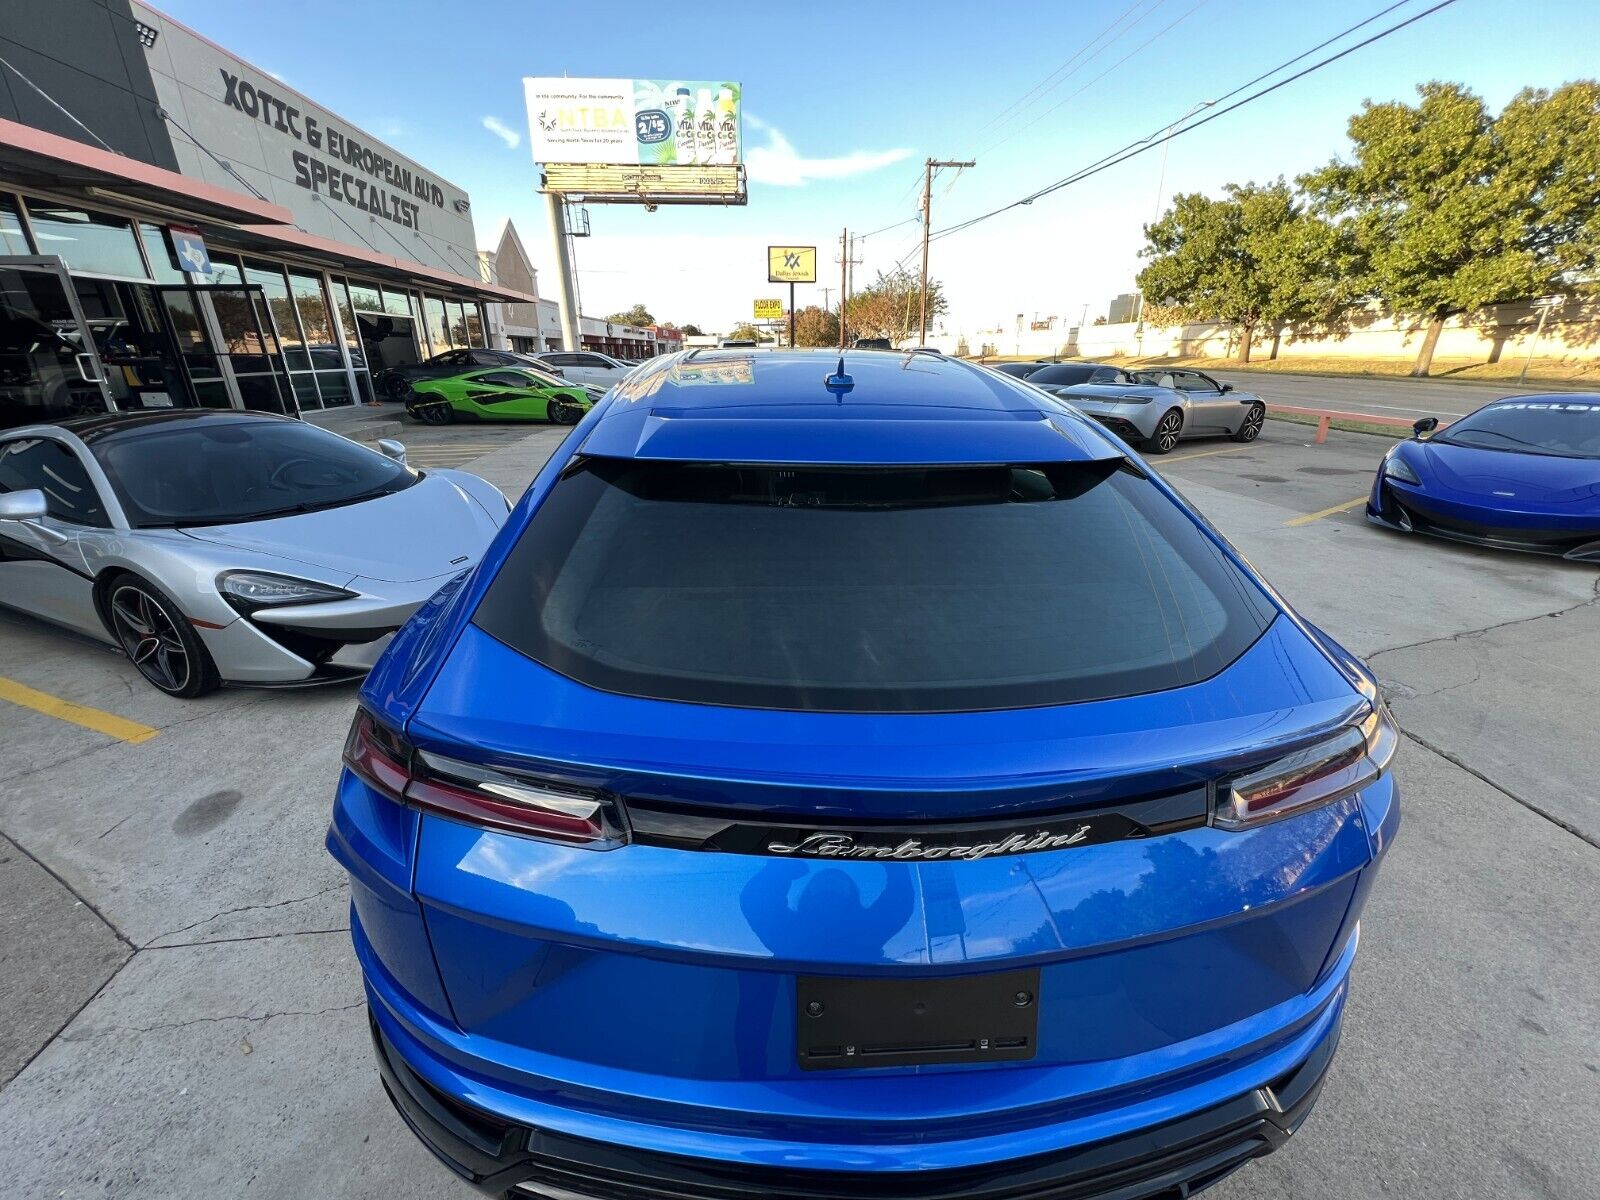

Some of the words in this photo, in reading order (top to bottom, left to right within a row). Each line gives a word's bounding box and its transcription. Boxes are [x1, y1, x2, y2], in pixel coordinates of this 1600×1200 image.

[559, 107, 627, 128] NTBA
[677, 120, 693, 130] VITA
[697, 120, 714, 131] VITA
[718, 121, 735, 132] VITA
[220, 68, 302, 140] XOTIC
[305, 116, 323, 149] &
[326, 126, 412, 195] EUROPEAN
[414, 174, 444, 209] AUTO
[292, 150, 420, 231] SPECIALIST
[755, 300, 769, 309] FLOOR
[769, 300, 780, 309] EXPO
[768, 825, 1091, 860] Lamborghini
